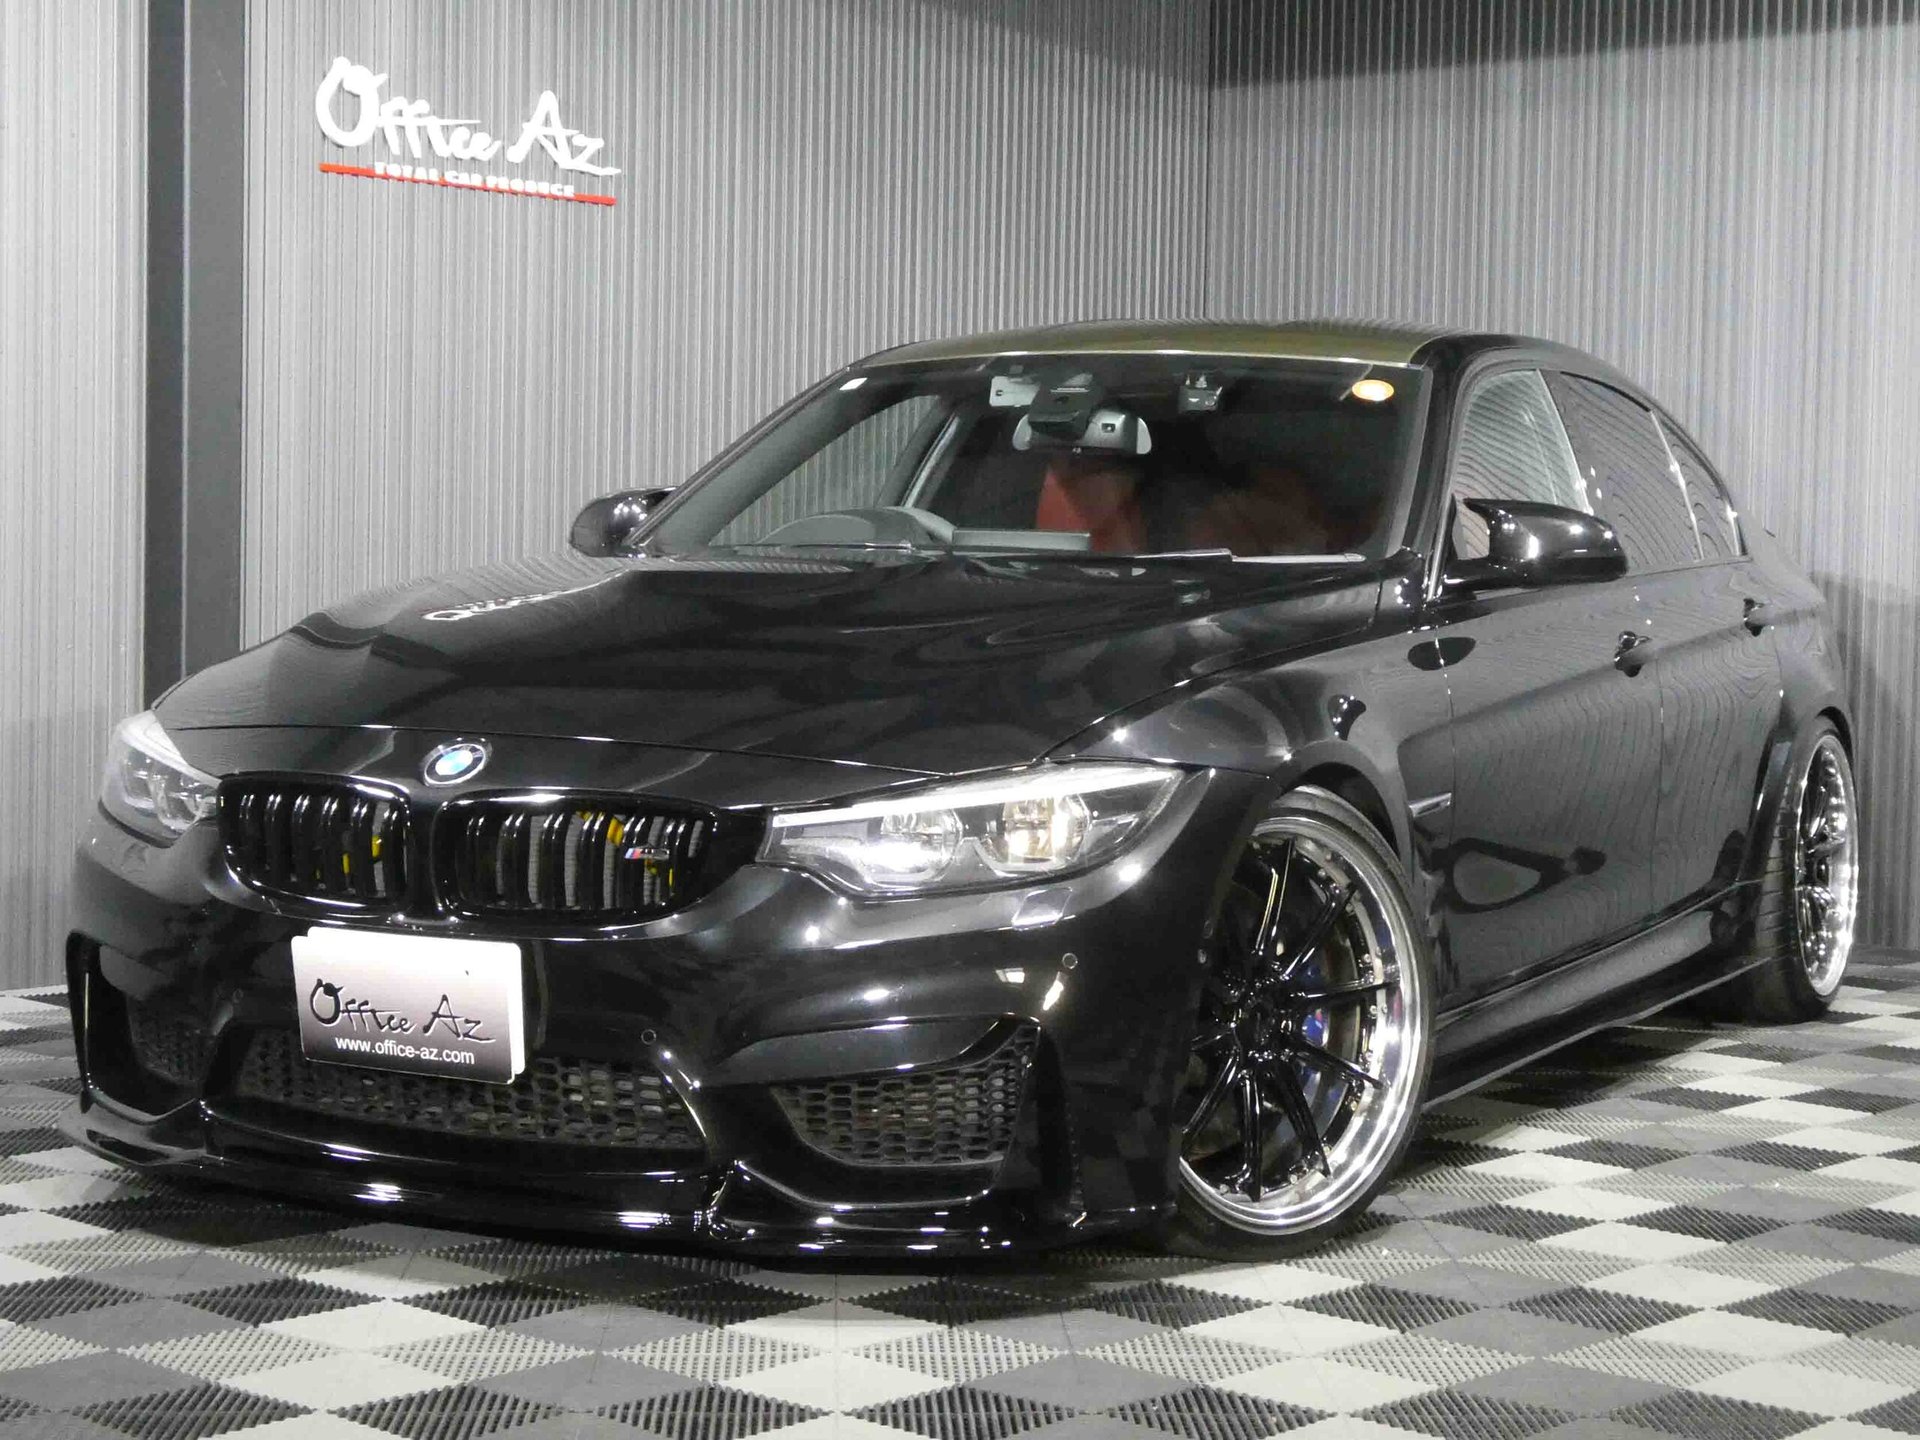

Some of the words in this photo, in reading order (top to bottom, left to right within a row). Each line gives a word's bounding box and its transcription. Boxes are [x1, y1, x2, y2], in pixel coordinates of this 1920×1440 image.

[315, 56, 502, 161] Office
[507, 90, 622, 176] Az
[310, 978, 416, 1035] Office
[423, 994, 497, 1044] Az
[335, 1036, 475, 1065] www.office-az.com
